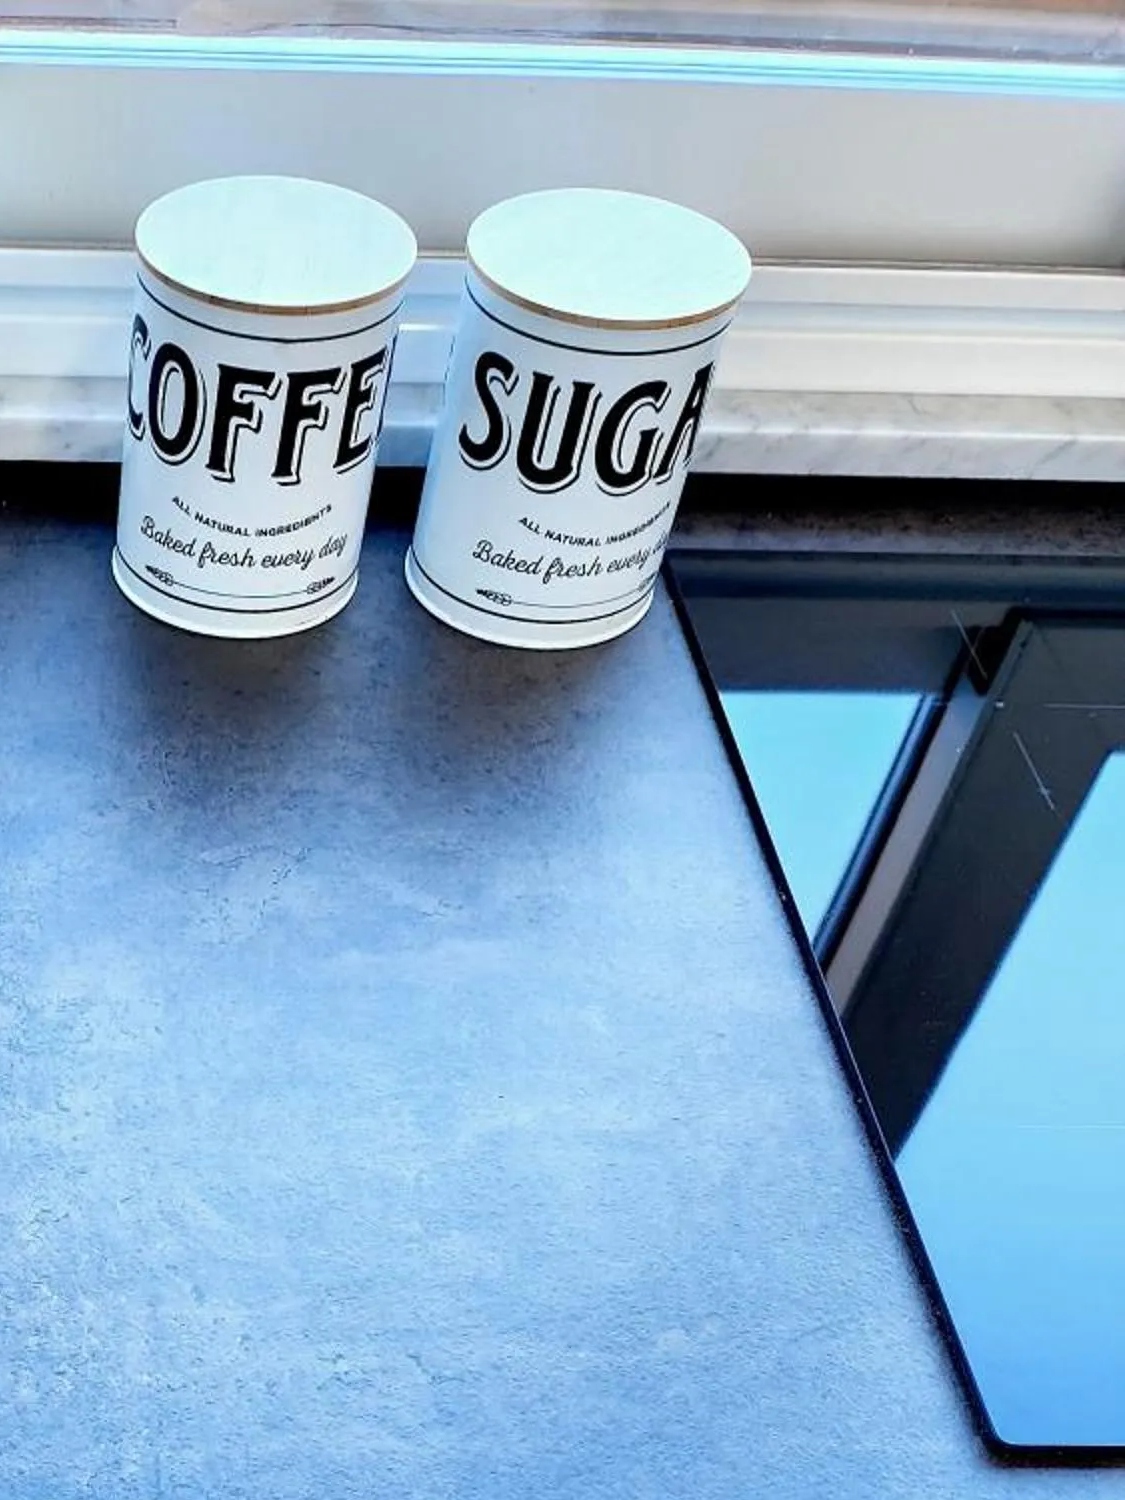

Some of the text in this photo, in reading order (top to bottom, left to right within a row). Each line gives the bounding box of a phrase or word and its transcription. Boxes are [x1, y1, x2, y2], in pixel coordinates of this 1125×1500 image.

[127, 313, 394, 485] COFFE
[171, 496, 333, 537] ALL NATURAL INGREDIENTS
[518, 517, 540, 535] ALL
[544, 530, 602, 547] NATURAL
[140, 515, 348, 570] Baked fresh every day
[472, 539, 544, 576] Baked
[542, 555, 604, 585] fresh
